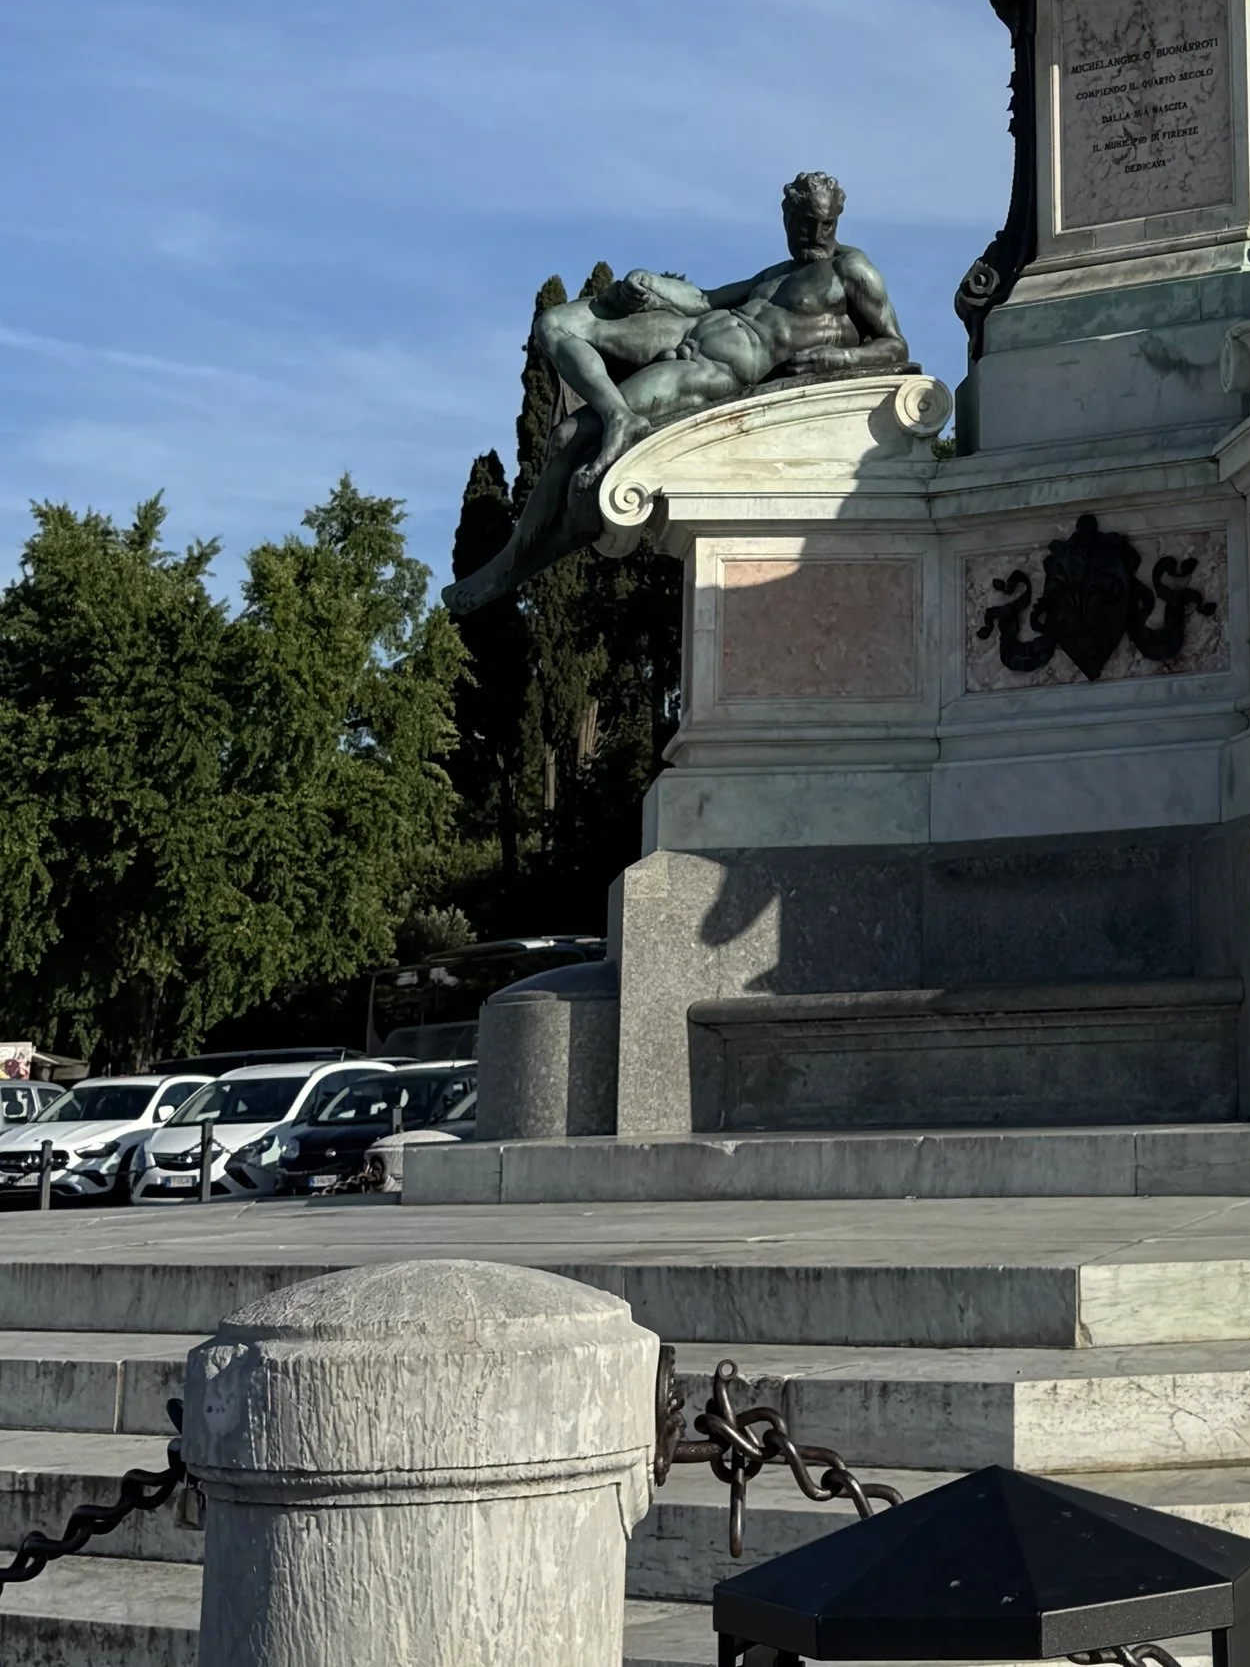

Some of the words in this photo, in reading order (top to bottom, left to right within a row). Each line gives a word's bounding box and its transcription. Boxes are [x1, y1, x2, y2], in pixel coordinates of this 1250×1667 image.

[1071, 50, 1151, 75] MICHELANGIOLO
[1156, 38, 1218, 59] BUONARROTI
[1076, 84, 1127, 101] COMPIENDO
[1129, 82, 1138, 91] IL
[1141, 74, 1176, 90] QUARTO
[1179, 68, 1214, 81] SECOLO
[1101, 113, 1131, 124] DALLA
[1133, 109, 1149, 119] SUA
[1152, 101, 1189, 115] NASCITA
[1092, 144, 1102, 153] IL
[1104, 136, 1148, 151] MUNICIPIO
[1151, 133, 1160, 142] DI
[1162, 126, 1199, 139] FIRENZE
[1124, 158, 1167, 174] DEDICAVA
